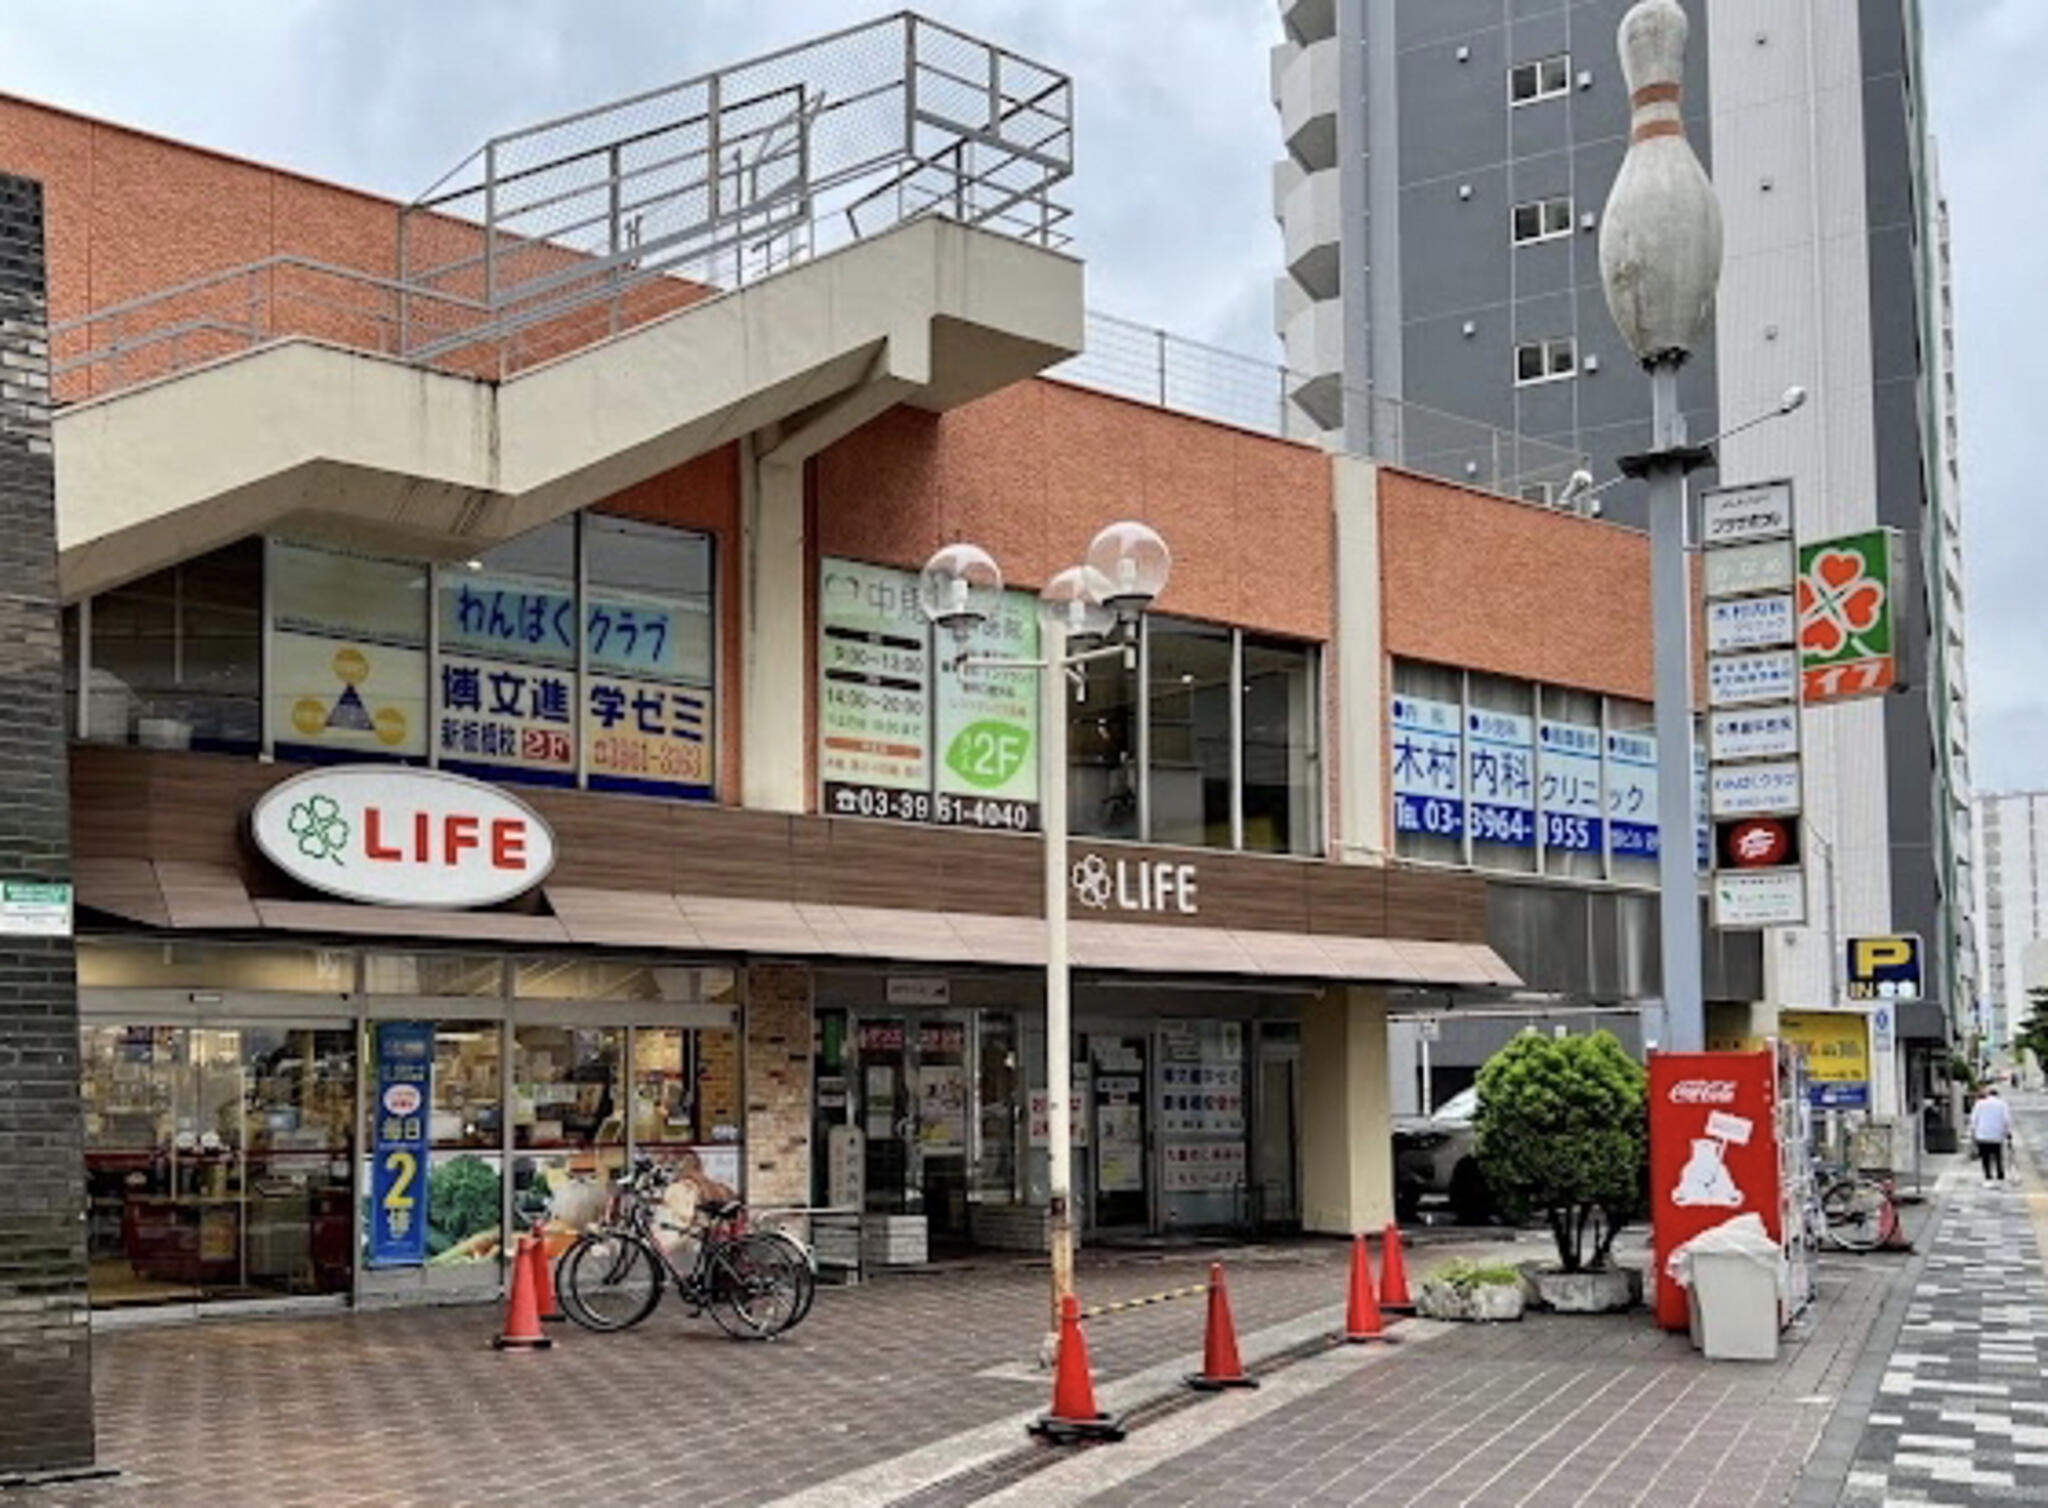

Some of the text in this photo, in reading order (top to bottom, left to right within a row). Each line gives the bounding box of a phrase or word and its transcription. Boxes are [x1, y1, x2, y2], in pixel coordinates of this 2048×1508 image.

[522, 729, 571, 763] 2F
[973, 730, 1020, 780] 2F
[858, 788, 1028, 830] 03-3961-4040
[1423, 799, 1590, 848] 03-3964-1955
[363, 807, 527, 871] LIFE
[1116, 859, 1198, 914] LIFE
[1856, 939, 1912, 977] P
